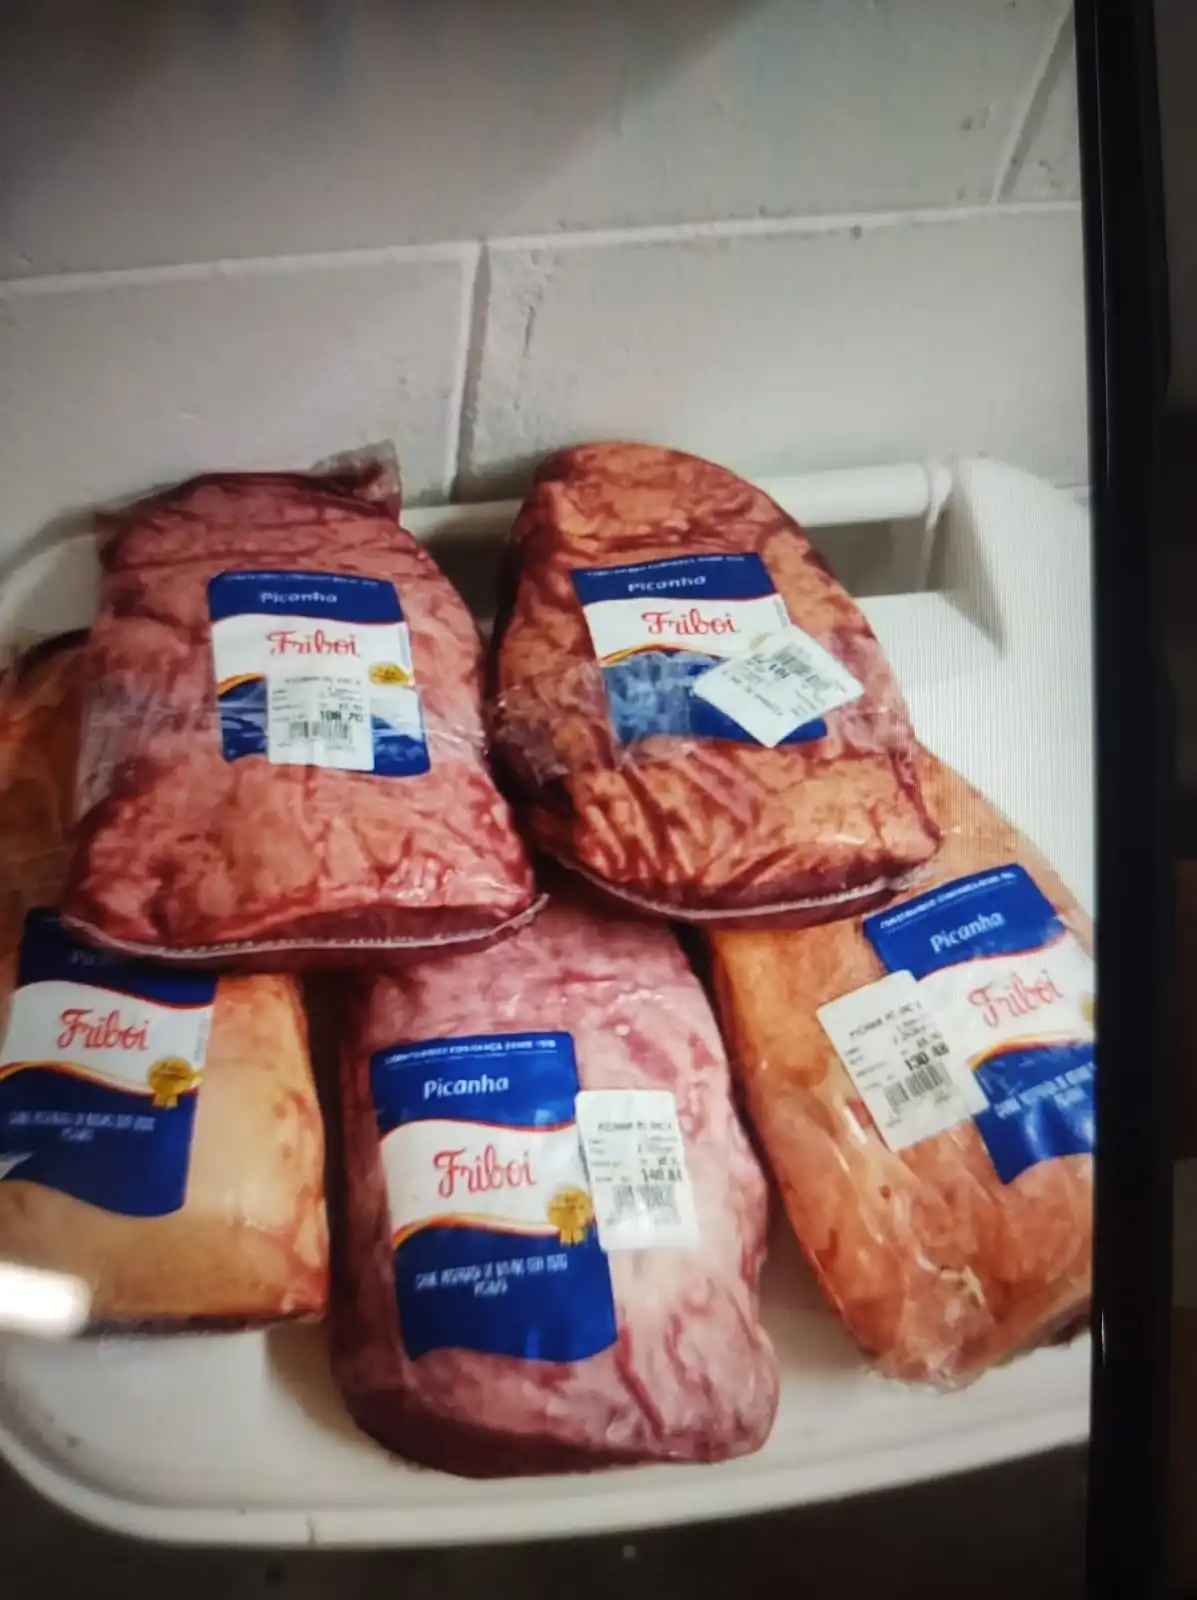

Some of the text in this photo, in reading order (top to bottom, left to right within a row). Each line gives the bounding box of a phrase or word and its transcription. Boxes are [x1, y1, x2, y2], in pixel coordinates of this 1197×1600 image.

[260, 591, 338, 604] Picanha
[628, 575, 707, 593] Picanha
[642, 608, 739, 636] Friboi
[266, 629, 360, 657] Friboi
[930, 912, 1005, 954] Picanha
[968, 968, 1064, 1029] Friboi
[57, 1008, 149, 1051] Friboi
[424, 1073, 510, 1101] Picanha
[433, 1144, 537, 1199] Friboi
